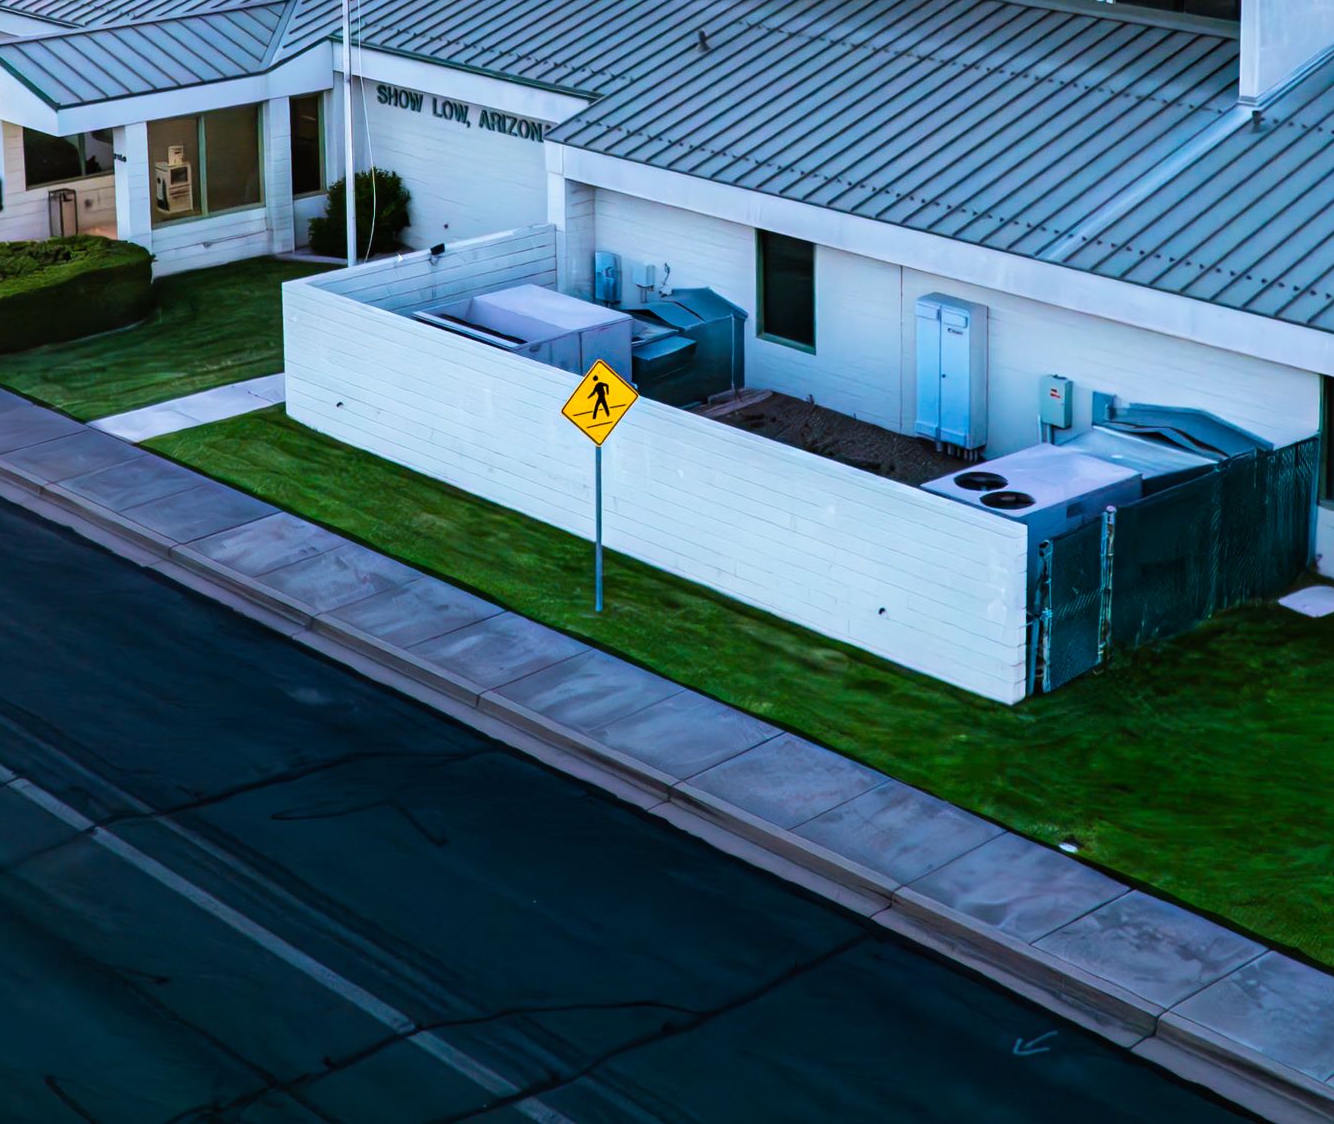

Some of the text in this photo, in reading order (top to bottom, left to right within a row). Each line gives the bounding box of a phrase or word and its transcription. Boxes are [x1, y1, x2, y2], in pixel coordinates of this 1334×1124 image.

[376, 84, 552, 144] SHOW LOW, ARIZON
